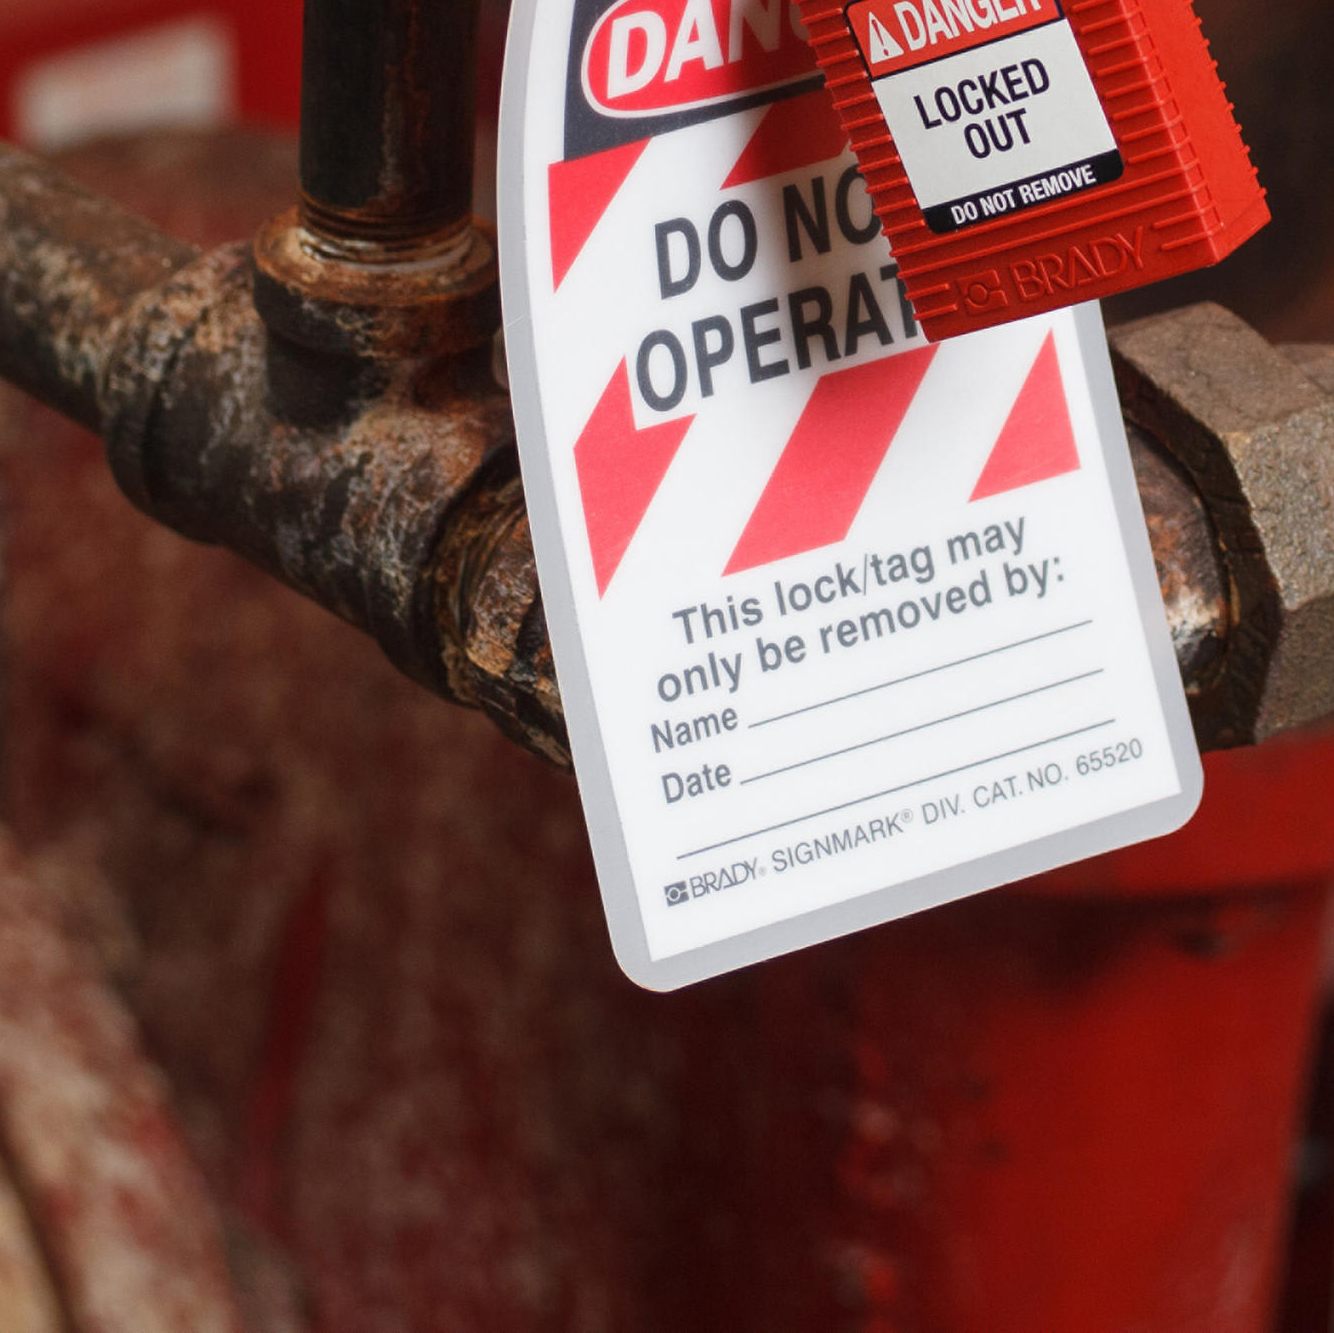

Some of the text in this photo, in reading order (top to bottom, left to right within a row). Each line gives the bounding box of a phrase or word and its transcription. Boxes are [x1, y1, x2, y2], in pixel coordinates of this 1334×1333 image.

[913, 58, 1050, 130] LOCKED
[963, 107, 1031, 159] OUT
[655, 164, 882, 300] DO NO
[951, 164, 1097, 225] DO NOT REMOVE
[1010, 226, 1143, 301] BRADY
[636, 263, 919, 412] OPERAT
[672, 516, 1025, 645] This lock/tag may
[657, 556, 1064, 702] only be removed by:
[651, 703, 739, 753] Name
[661, 760, 731, 803] Date
[922, 794, 965, 824] DIV.
[973, 776, 1023, 808] CAT.
[1027, 763, 1069, 791] NO.
[1076, 738, 1143, 776] 65520
